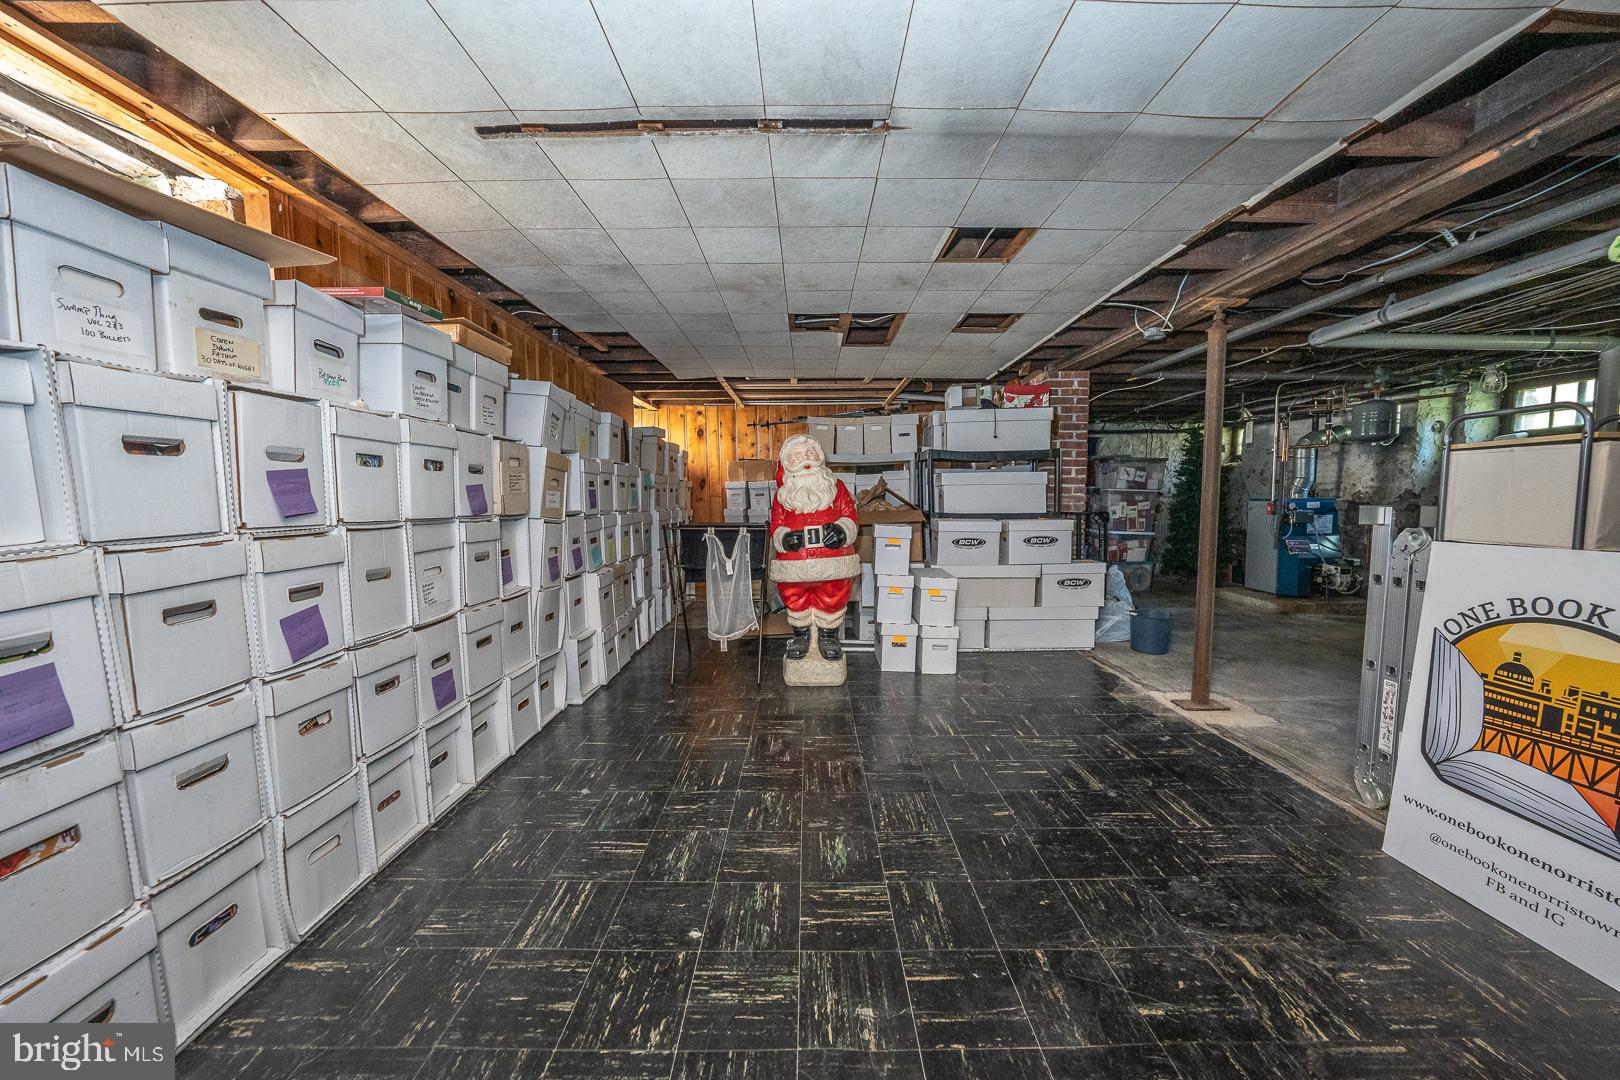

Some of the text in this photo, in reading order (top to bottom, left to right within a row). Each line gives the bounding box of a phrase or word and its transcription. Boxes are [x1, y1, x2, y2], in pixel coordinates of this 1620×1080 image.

[80, 326, 96, 338] 100
[958, 538, 981, 546] BCW
[1029, 536, 1052, 544] BCW
[1063, 579, 1086, 587] BCW
[1443, 596, 1617, 636] ONE BOOK
[1485, 876, 1567, 928] FB and IG
